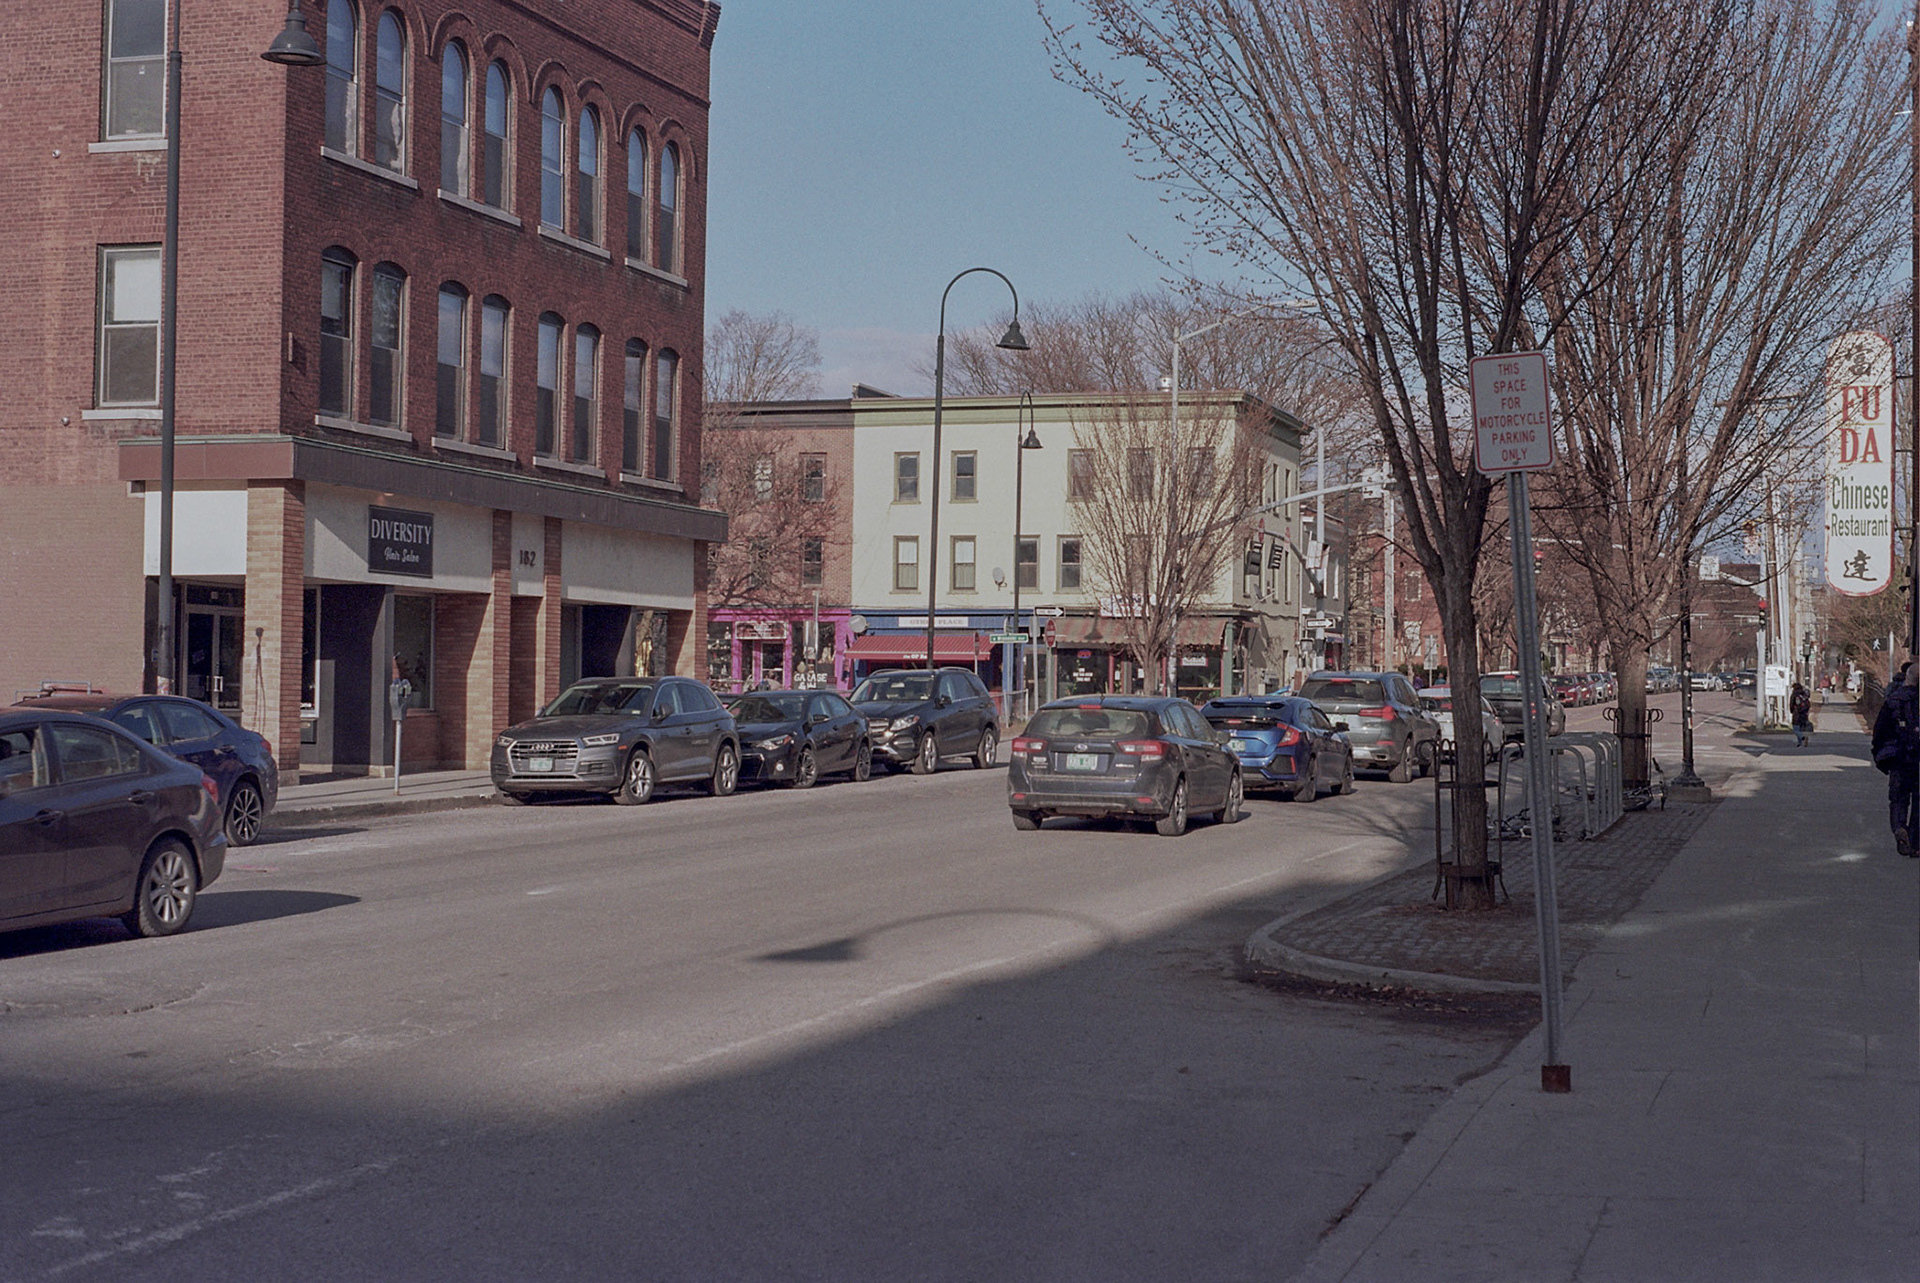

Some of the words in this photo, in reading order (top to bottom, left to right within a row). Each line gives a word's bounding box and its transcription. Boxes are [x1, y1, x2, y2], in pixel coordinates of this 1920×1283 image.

[1498, 363, 1520, 376] THIS
[1493, 379, 1527, 394] SPACE
[1501, 397, 1521, 410] FOR
[1841, 385, 1881, 422] FU
[1479, 412, 1546, 428] MOTORCYCLE
[1491, 430, 1536, 446] PARKING
[1838, 427, 1881, 464] DA
[1501, 448, 1528, 462] ONLY
[1832, 477, 1888, 510] Chinese
[371, 519, 432, 545] DIVERSITY
[1831, 513, 1888, 537] Restaurant
[384, 546, 400, 561] Hair
[1843, 550, 1878, 582] 達
